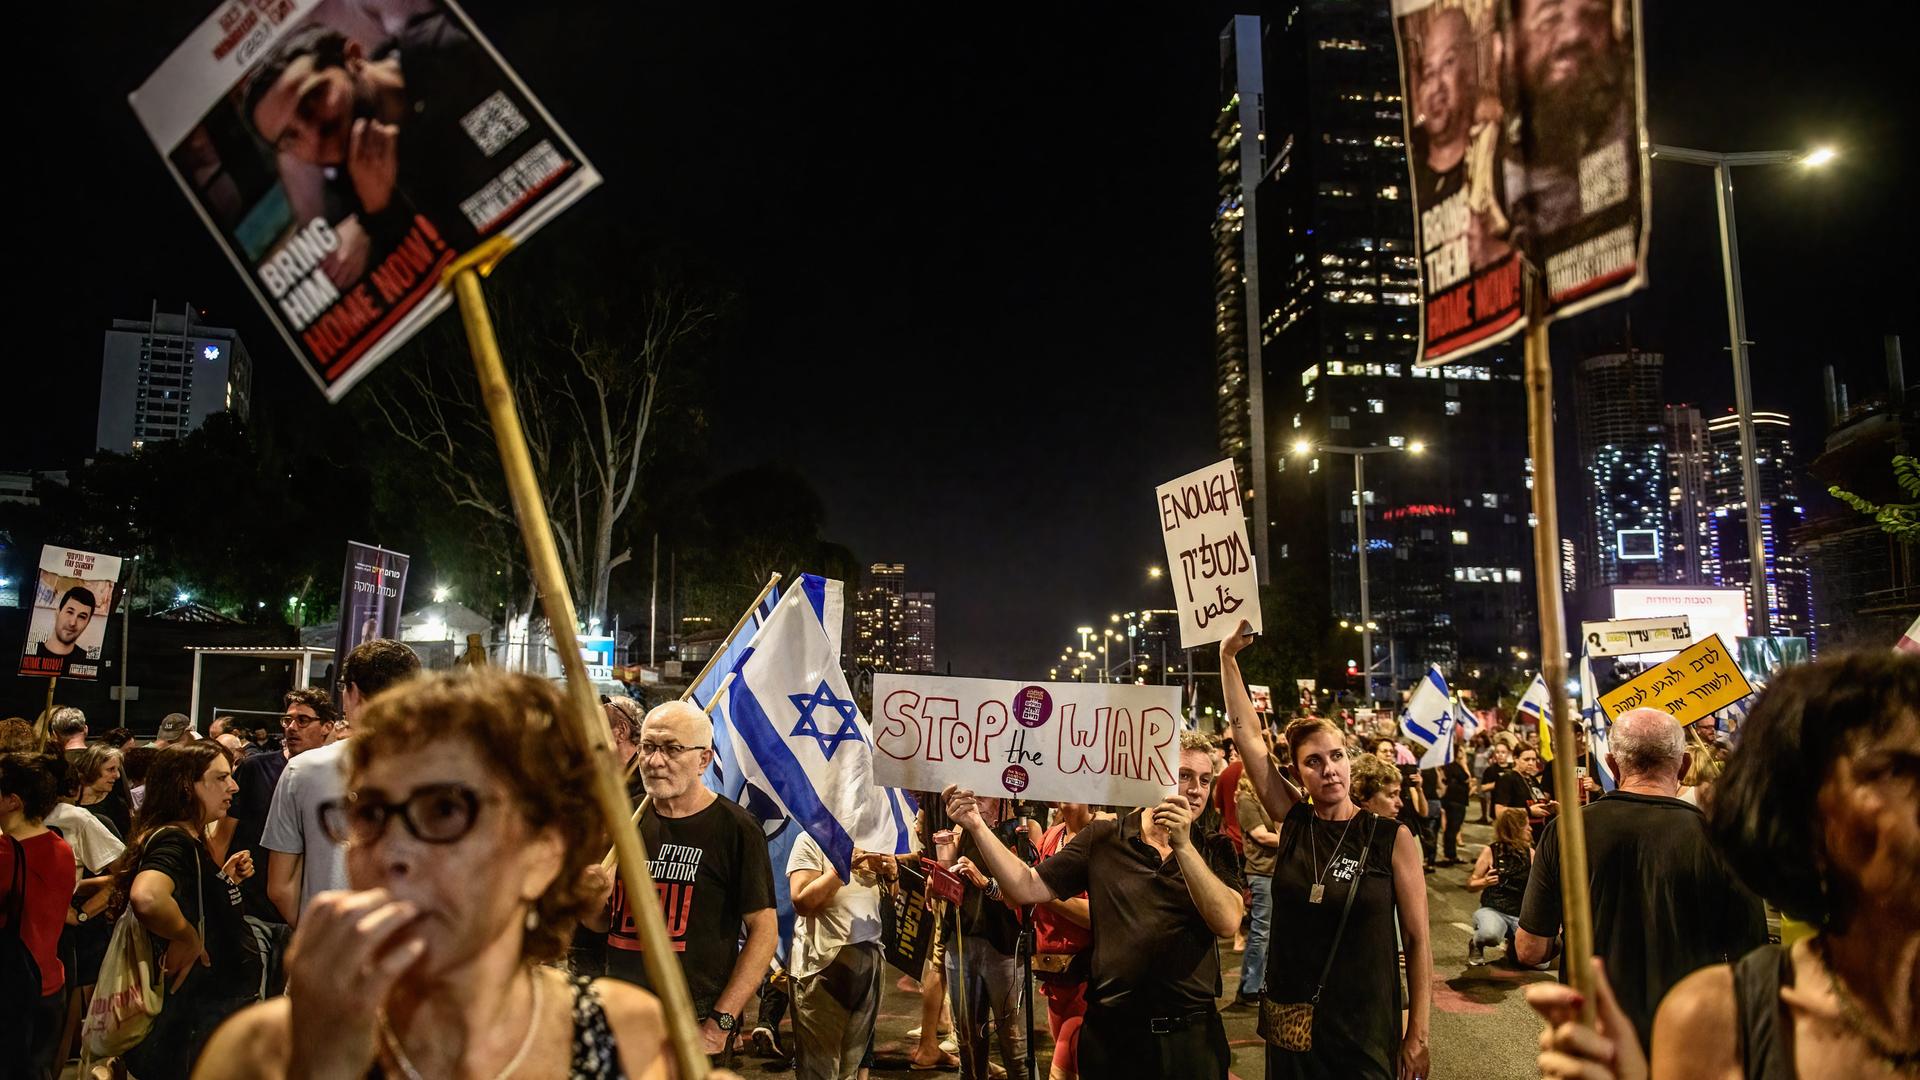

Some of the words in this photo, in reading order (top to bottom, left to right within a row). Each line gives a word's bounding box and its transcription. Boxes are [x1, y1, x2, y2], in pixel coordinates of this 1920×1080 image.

[257, 217, 338, 299] BRING
[1424, 235, 1471, 295] THEM
[279, 269, 341, 331] HIM
[303, 284, 382, 363] HOME
[371, 214, 446, 301] NOW!
[1161, 469, 1241, 532] ENOUGH
[1180, 530, 1250, 603] מספיק
[354, 579, 375, 594] חלוקה
[1671, 622, 1691, 640] למה
[1613, 688, 1647, 714] לעסקה
[1687, 671, 1731, 701] ולשחרר
[1664, 696, 1687, 715] את
[1005, 729, 1043, 765] the
[1057, 703, 1177, 786] WAR
[658, 843, 703, 864] מחזירים
[666, 861, 698, 882] אותם
[1332, 869, 1352, 880] Life
